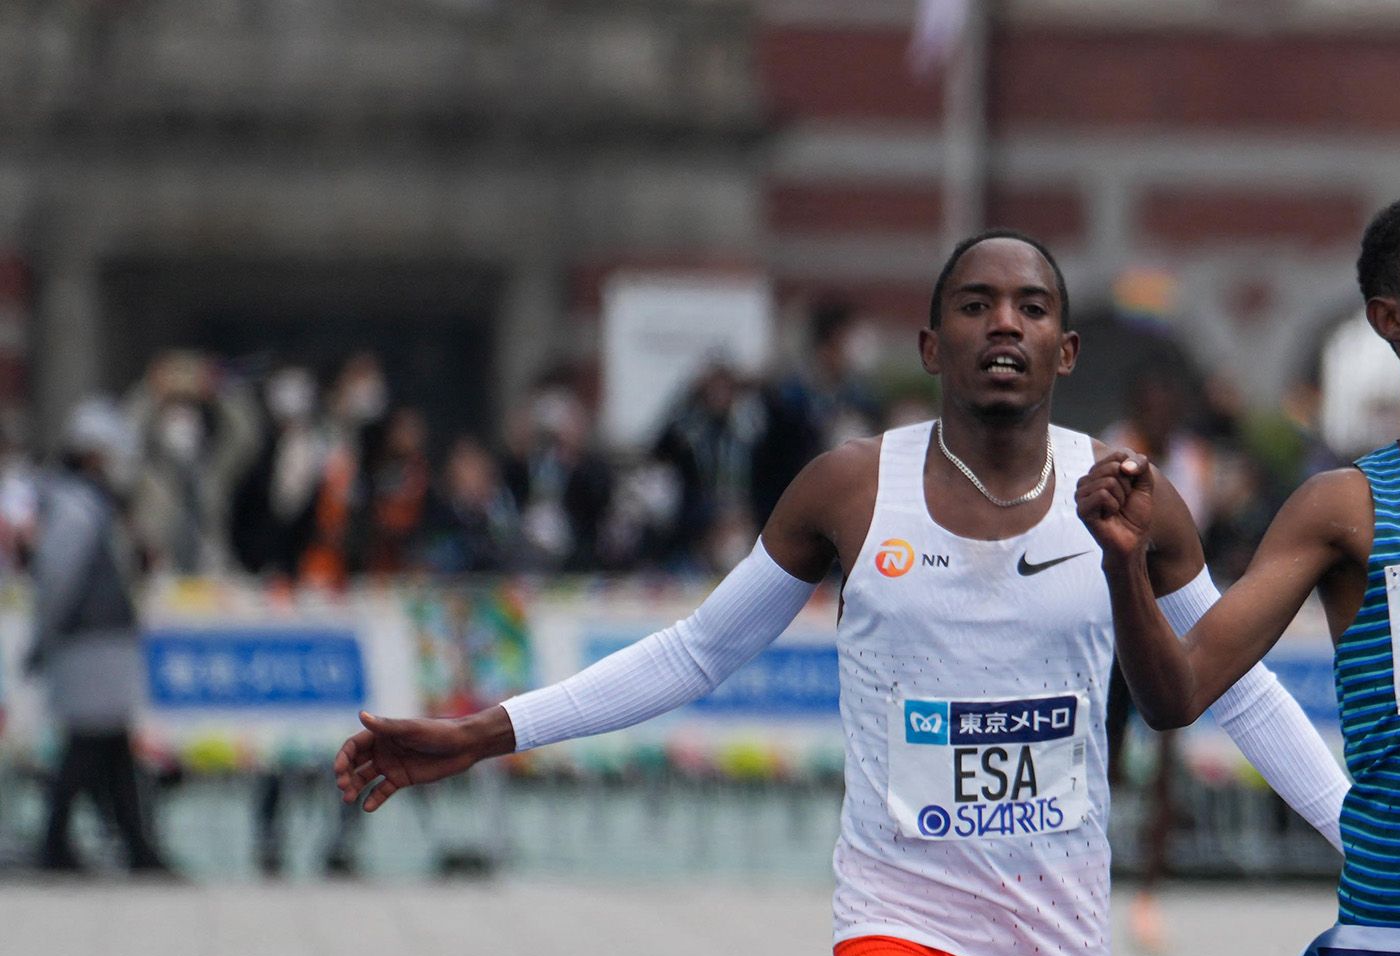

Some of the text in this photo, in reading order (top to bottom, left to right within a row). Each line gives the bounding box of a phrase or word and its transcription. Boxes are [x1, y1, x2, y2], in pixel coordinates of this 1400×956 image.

[922, 553, 950, 568] NN
[959, 706, 1070, 735] 東京メトロ
[954, 744, 1038, 802] ESA
